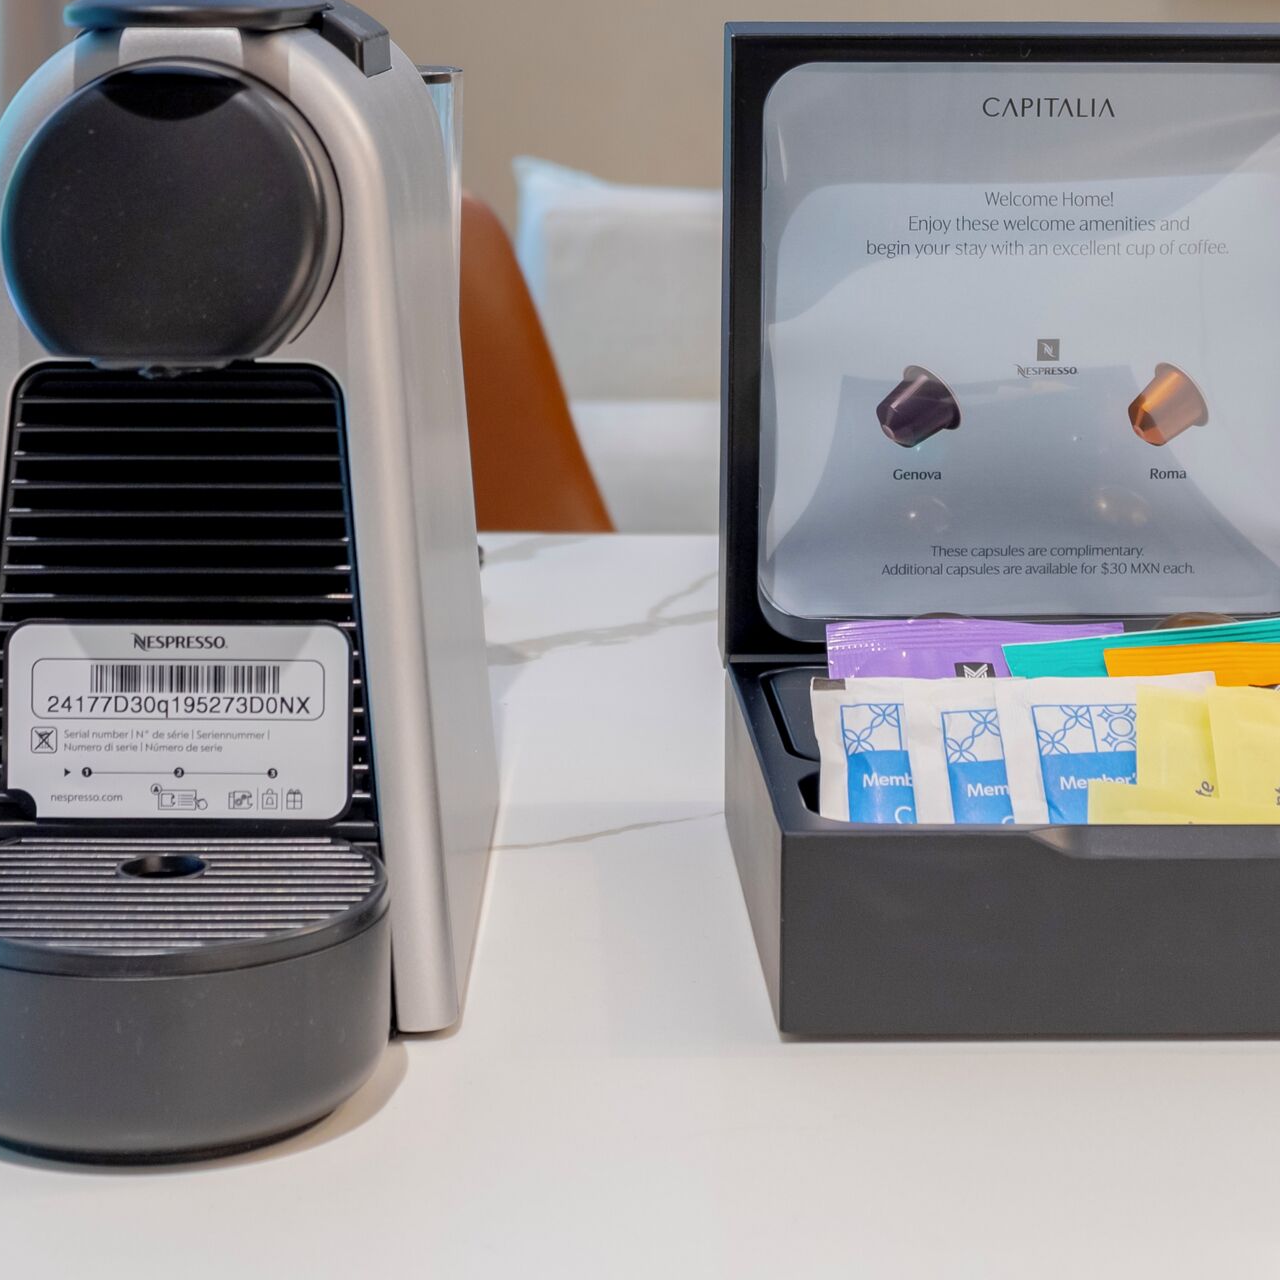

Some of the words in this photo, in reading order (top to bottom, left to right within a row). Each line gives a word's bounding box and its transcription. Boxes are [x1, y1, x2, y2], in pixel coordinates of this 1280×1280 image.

[982, 97, 1115, 118] CAPITALIA
[984, 191, 1058, 207] Welcome
[1062, 191, 1114, 207] Home!
[908, 216, 952, 235] Enjoy
[955, 216, 1000, 231] these
[1003, 216, 1075, 231] welcome
[1078, 216, 1156, 231] amenities
[1159, 215, 1190, 231] and
[866, 240, 910, 259] begin
[914, 243, 950, 259] your
[954, 241, 987, 259] stay
[991, 239, 1023, 255] with
[1028, 243, 1048, 256] an
[1052, 239, 1122, 256] excellent
[1125, 243, 1156, 258] cup
[1159, 239, 1176, 255] of
[1178, 239, 1230, 255] coffee.
[1013, 364, 1078, 378] NESPRESSO
[893, 468, 942, 480] Genova
[1149, 468, 1187, 480] Roma
[930, 545, 968, 557] These
[971, 545, 1025, 560] capsules
[1028, 547, 1048, 557] are
[1050, 545, 1144, 560] complimentary.
[881, 562, 943, 576] Additional
[946, 562, 1000, 578] capsules
[1002, 565, 1022, 575] are
[1025, 562, 1078, 575] available
[1080, 562, 1097, 574] for
[1100, 562, 1127, 575] $30
[1130, 562, 1160, 575] MXN
[1163, 562, 1195, 575] each.
[63, 729, 89, 739] Serial
[92, 729, 128, 739] number
[152, 730, 165, 739] de
[167, 729, 189, 739] série
[196, 730, 264, 740] Seriennummer
[63, 743, 102, 752] Numero
[104, 743, 114, 752] di
[116, 743, 138, 752] serie
[145, 743, 183, 752] Número
[185, 743, 198, 752] de
[200, 743, 223, 752] serie
[50, 793, 123, 804] nespresso.com
